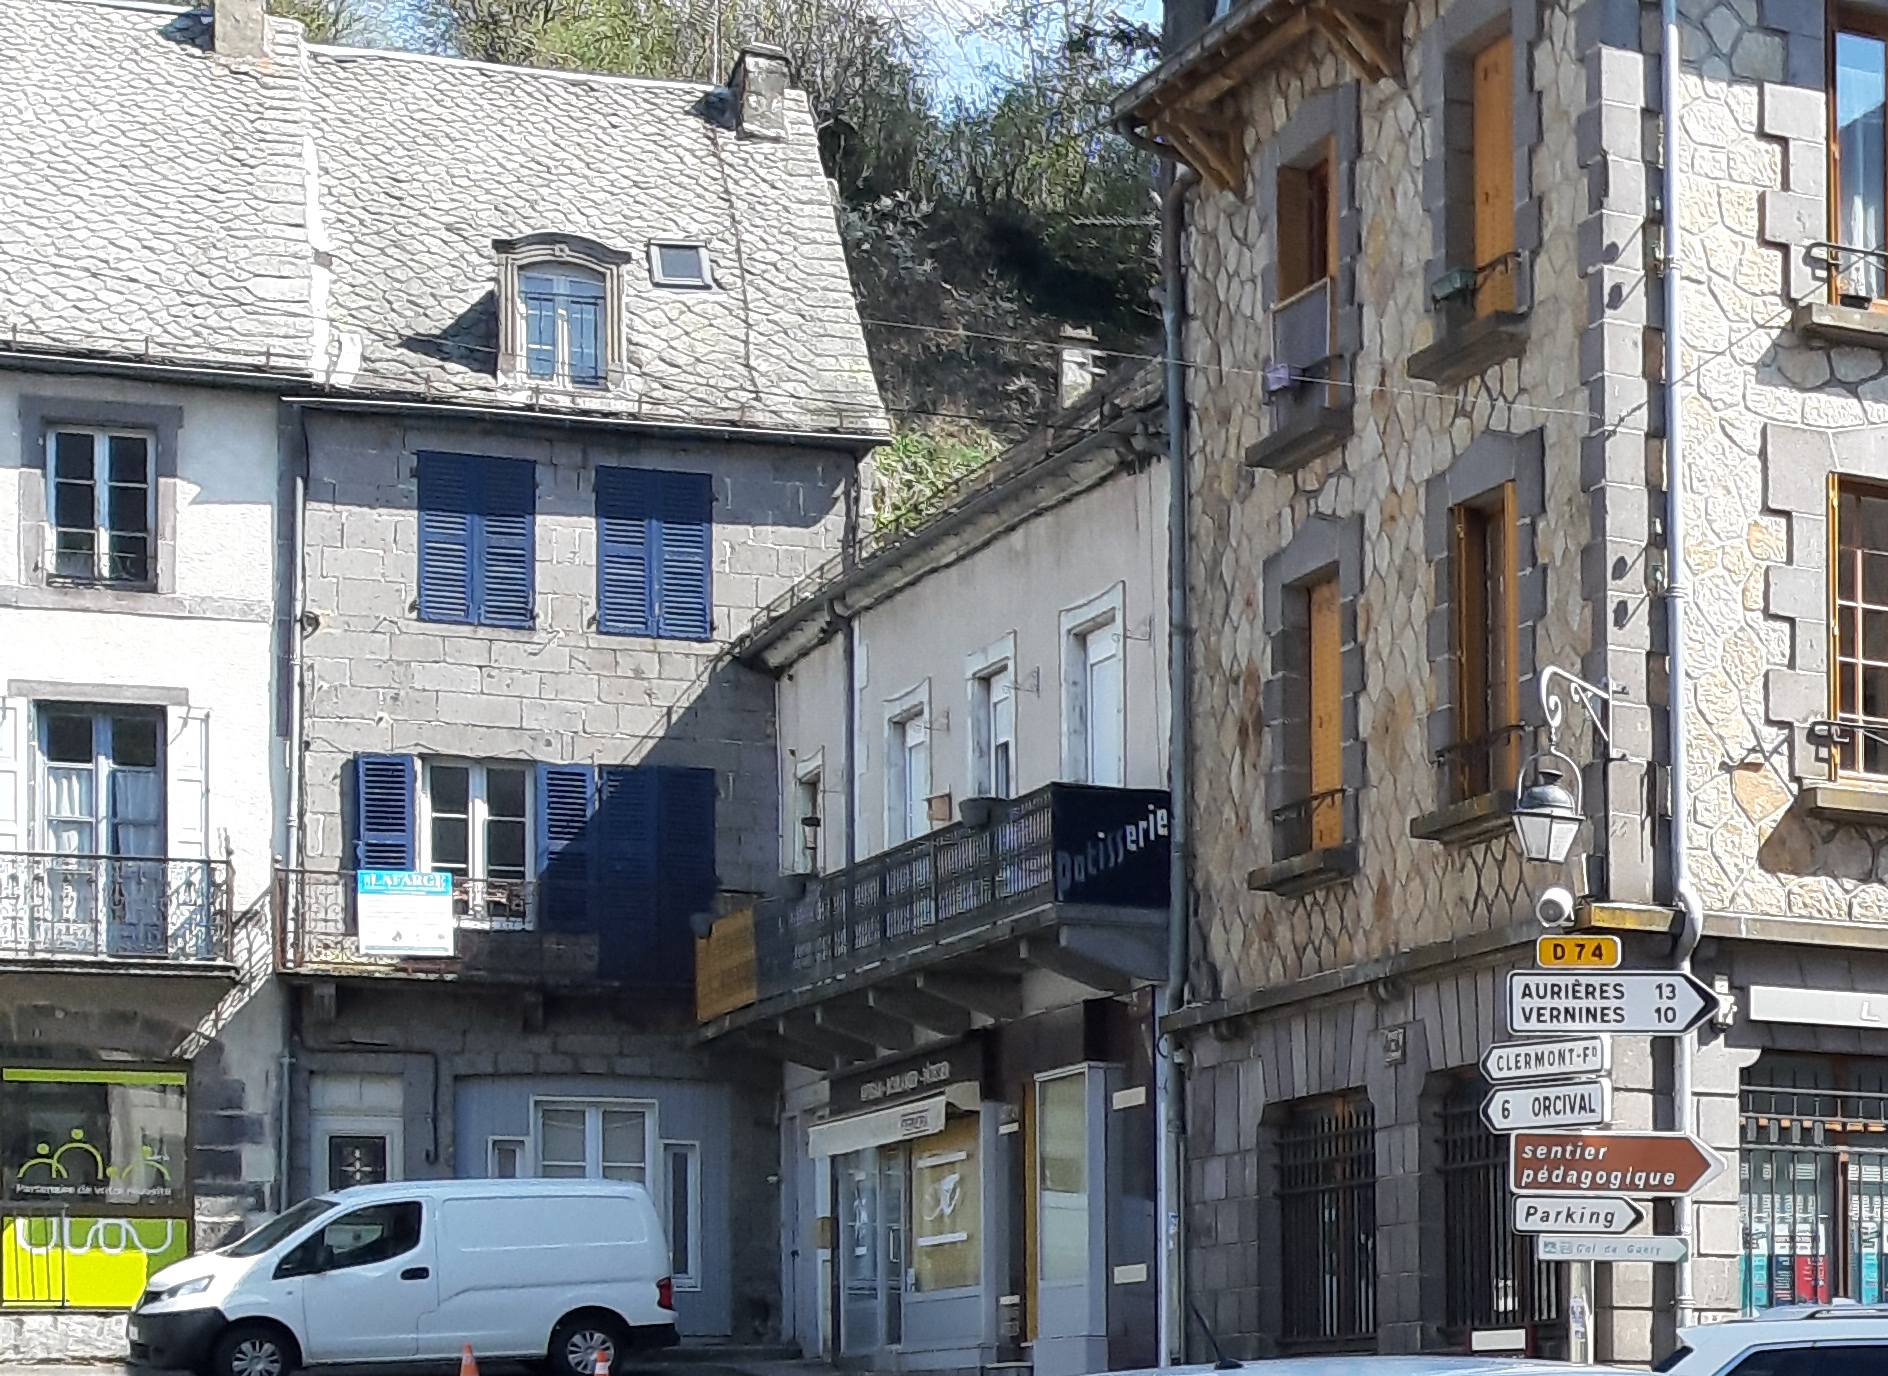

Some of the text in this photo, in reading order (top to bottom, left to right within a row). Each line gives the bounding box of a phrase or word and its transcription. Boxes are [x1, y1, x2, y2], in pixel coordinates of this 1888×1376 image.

[1552, 943, 1604, 961] D 74
[1521, 979, 1677, 1000] AURIÈRES 13
[1521, 1006, 1677, 1023] VERNINES 10
[1502, 1093, 1597, 1120] 6 ORCIVAL
[1522, 1140, 1608, 1160] sentier
[1521, 1164, 1676, 1189] pédagogique
[1524, 1205, 1616, 1228] Parking
